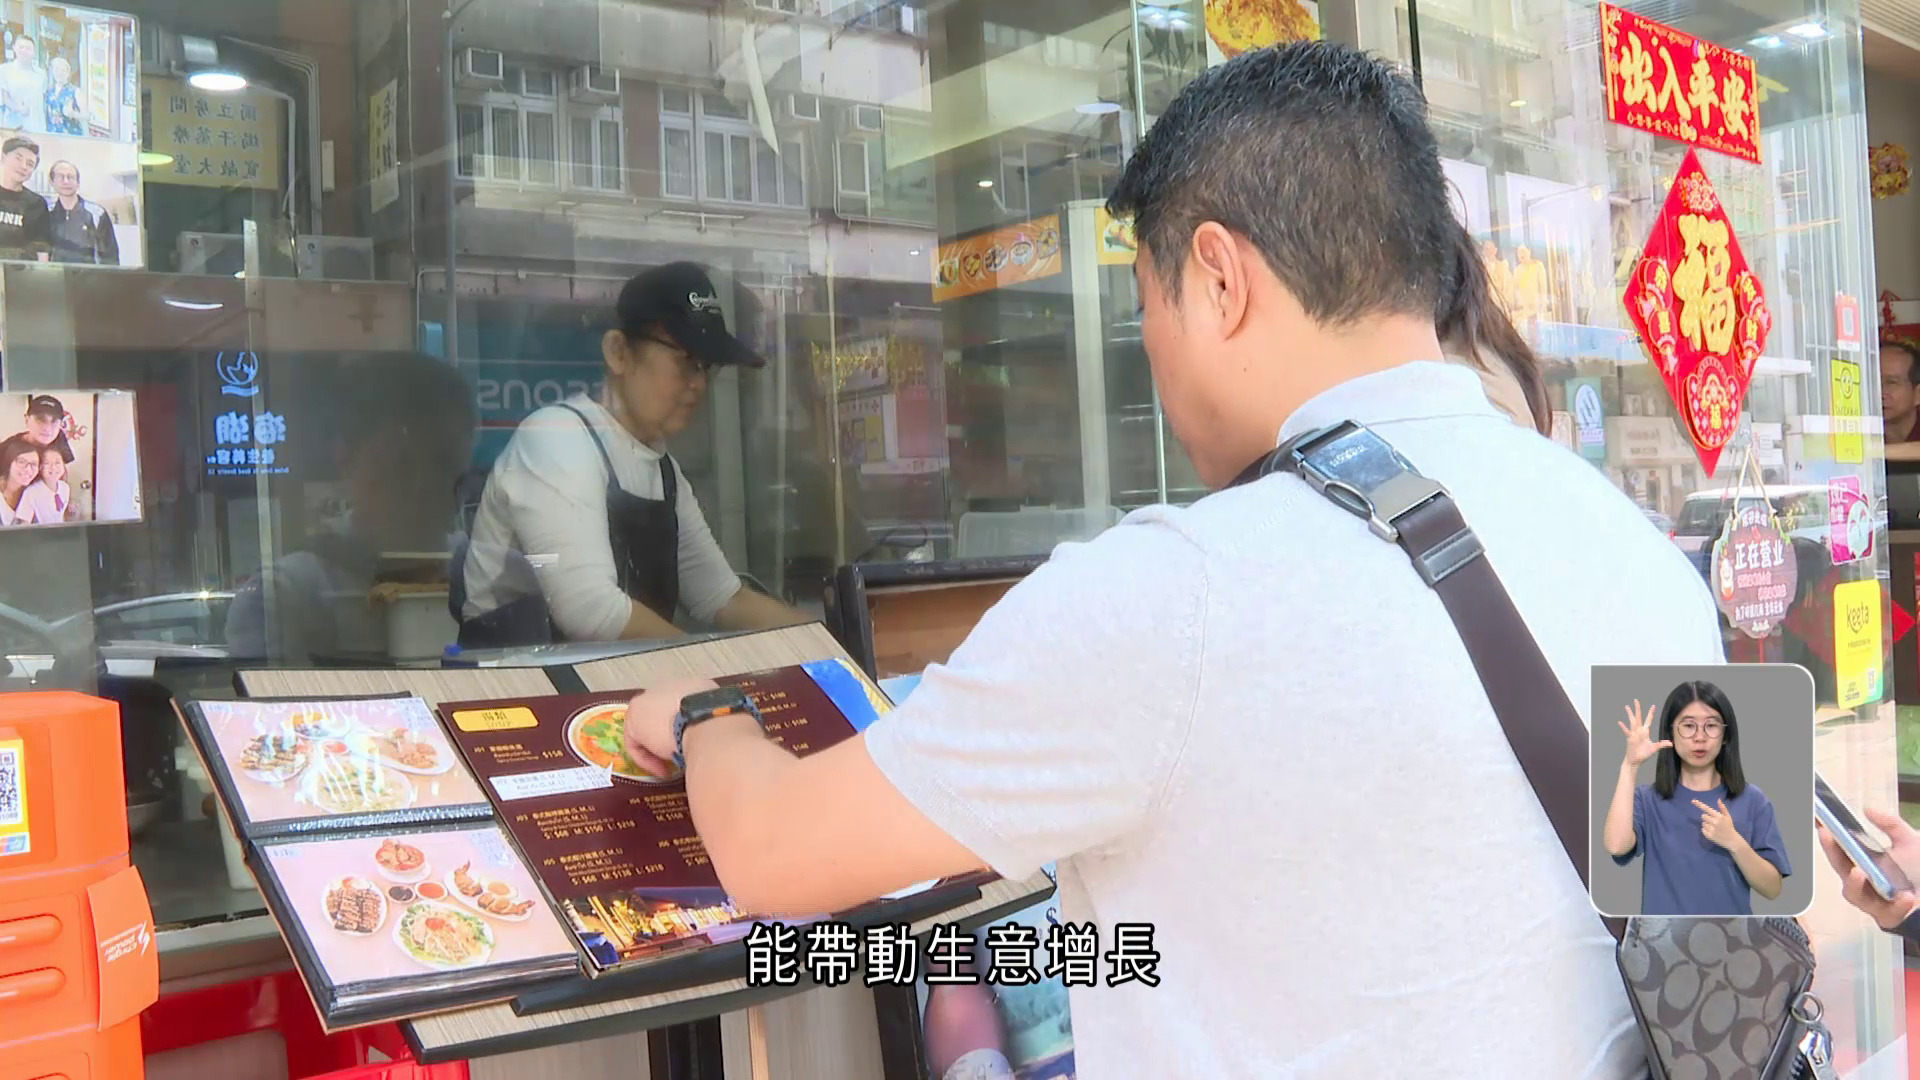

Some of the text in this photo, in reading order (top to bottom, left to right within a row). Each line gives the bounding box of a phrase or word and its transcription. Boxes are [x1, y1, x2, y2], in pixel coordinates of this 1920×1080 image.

[1620, 31, 1750, 141] 出入平安
[1672, 214, 1736, 356] 福
[1735, 539, 1784, 570] 正在营业
[1847, 601, 1869, 628] keeta
